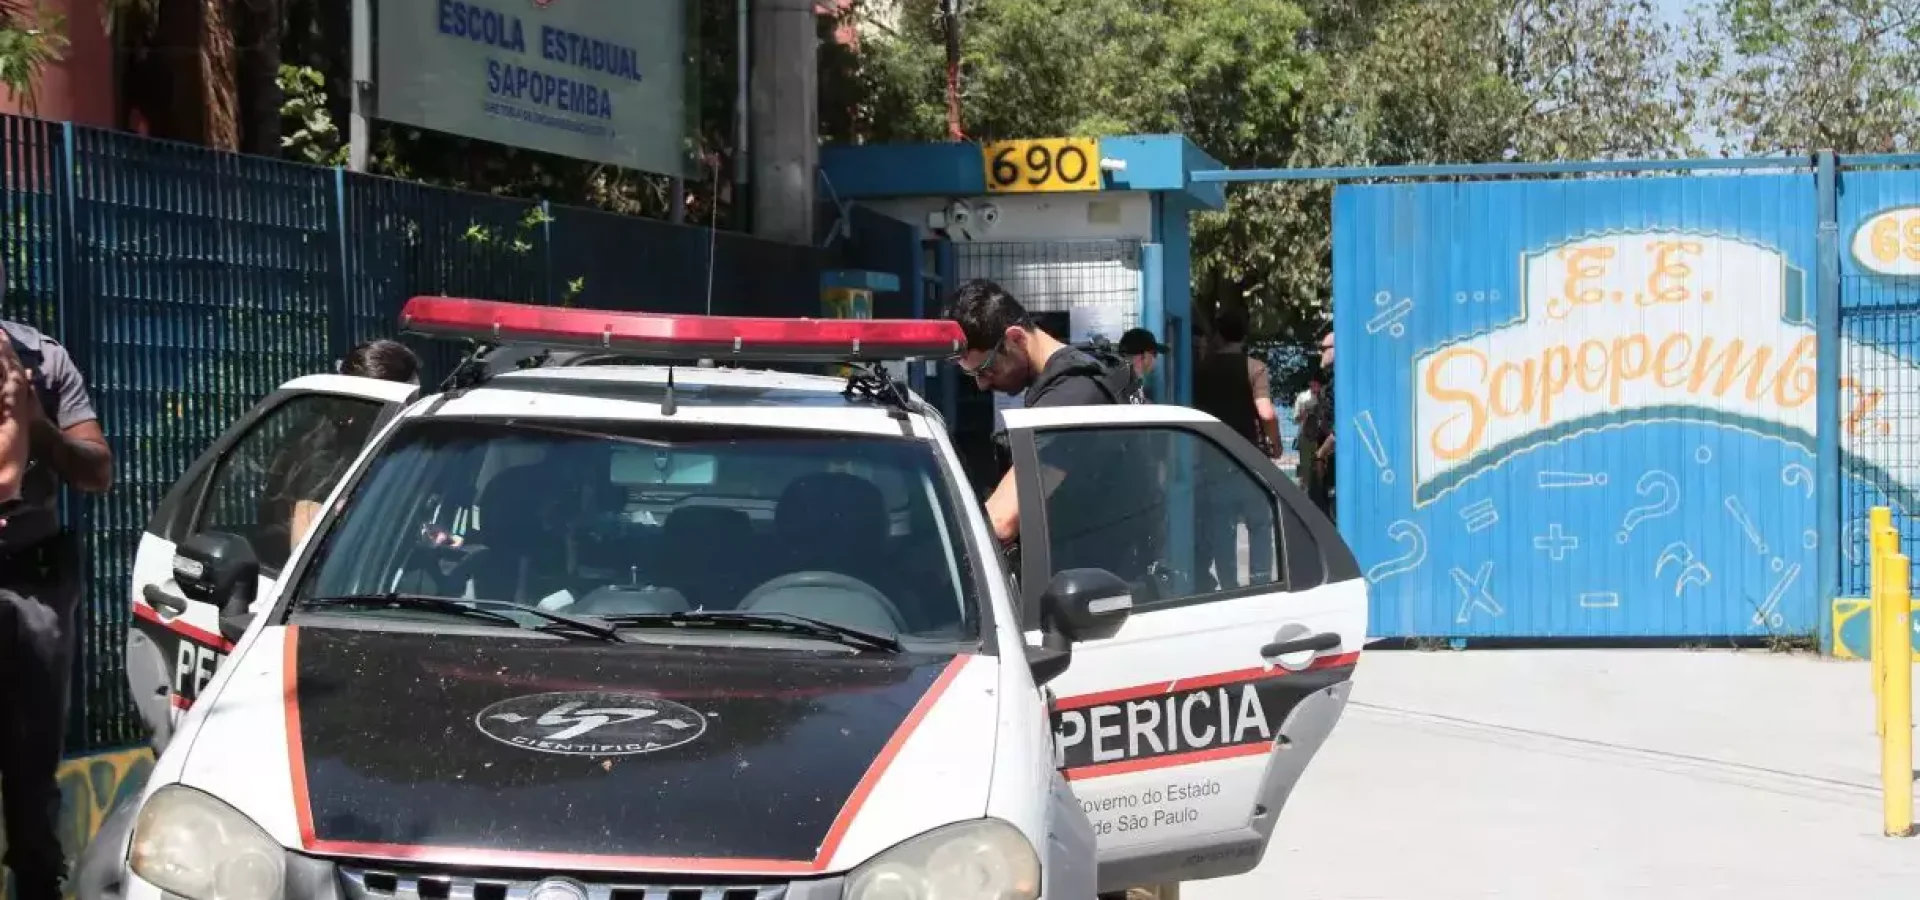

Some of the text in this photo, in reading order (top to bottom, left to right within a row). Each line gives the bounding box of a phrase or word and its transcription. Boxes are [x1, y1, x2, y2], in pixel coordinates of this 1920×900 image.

[438, 1, 643, 81] ESCOLA ESTADUAL
[487, 59, 612, 119] SAPOPEMBA
[991, 145, 1088, 186] 690
[1055, 679, 1271, 769] PERÍCIA
[1077, 779, 1221, 813] overno do Estado
[1094, 805, 1198, 835] de São Paulo
